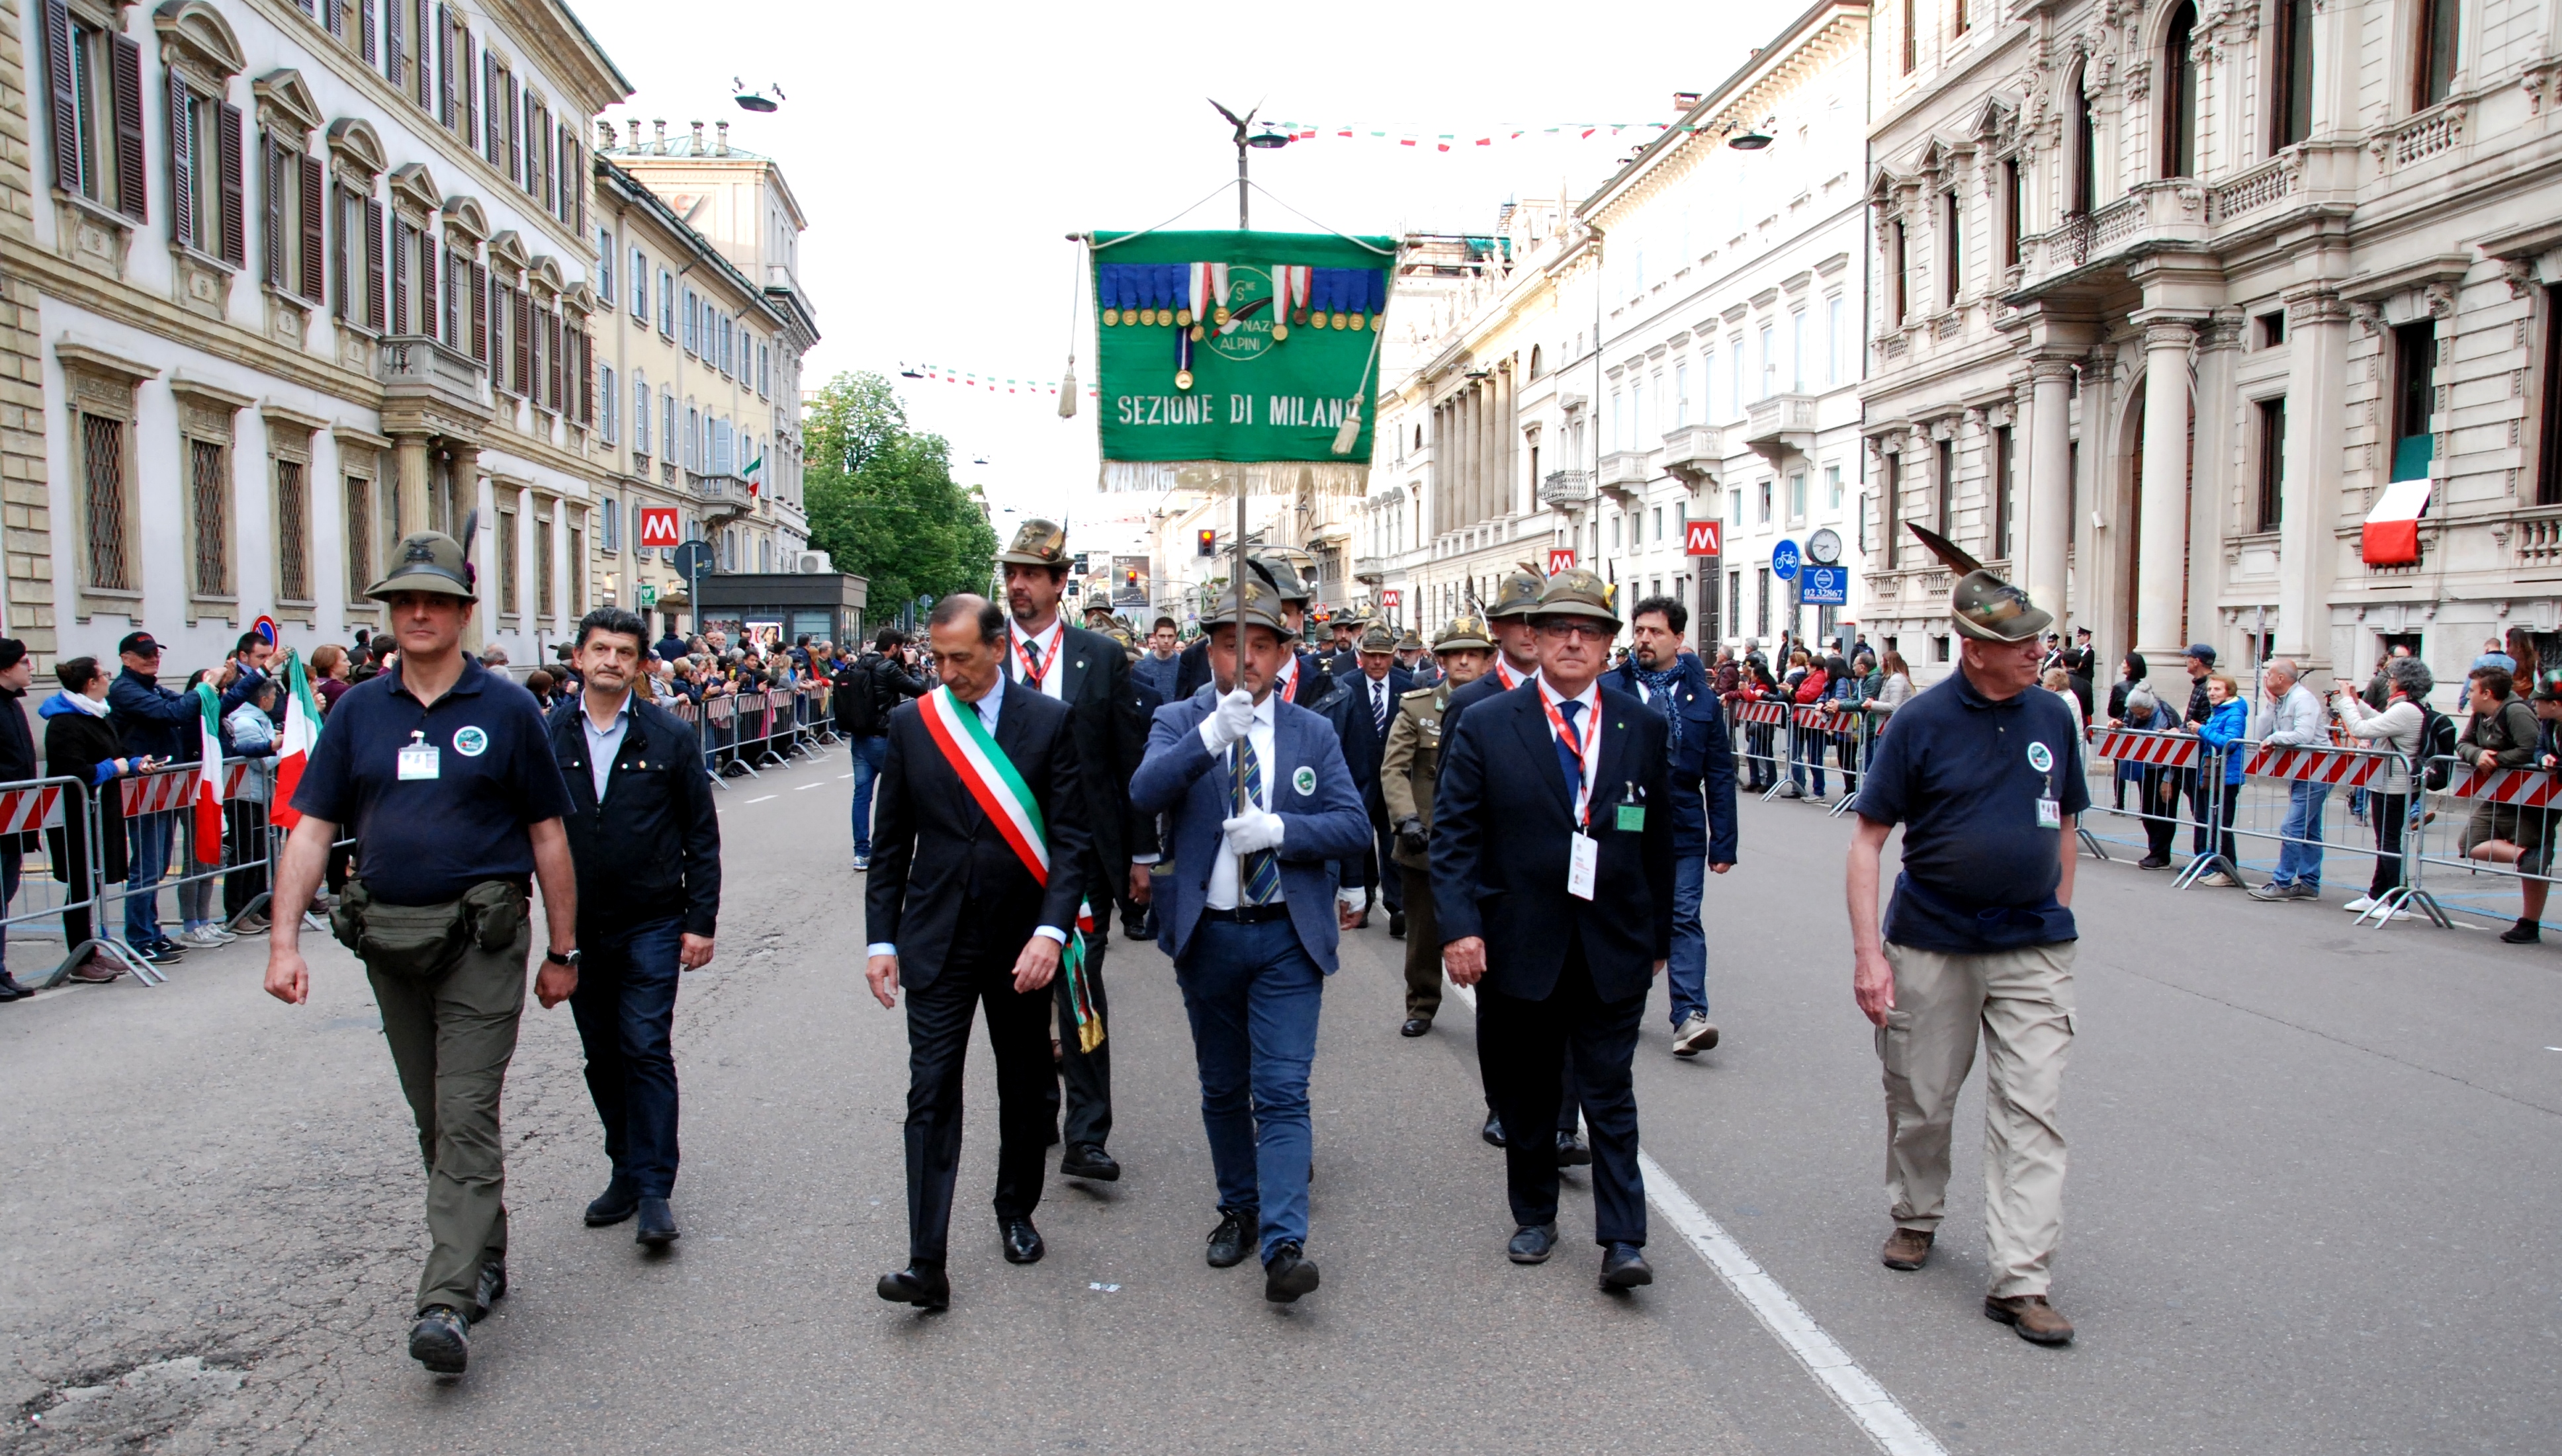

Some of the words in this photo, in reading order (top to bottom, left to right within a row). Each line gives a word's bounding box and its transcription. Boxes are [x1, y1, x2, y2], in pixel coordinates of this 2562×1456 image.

[1219, 337, 1260, 351] ALPINI
[1118, 394, 1214, 425] SEZIONE
[1230, 394, 1253, 425] DI
[643, 515, 677, 539] M
[1688, 527, 1718, 549] M
[1550, 554, 1573, 571] M
[1383, 593, 1397, 604] M
[1804, 588, 1815, 597] 02
[1816, 588, 1843, 598] 32867
